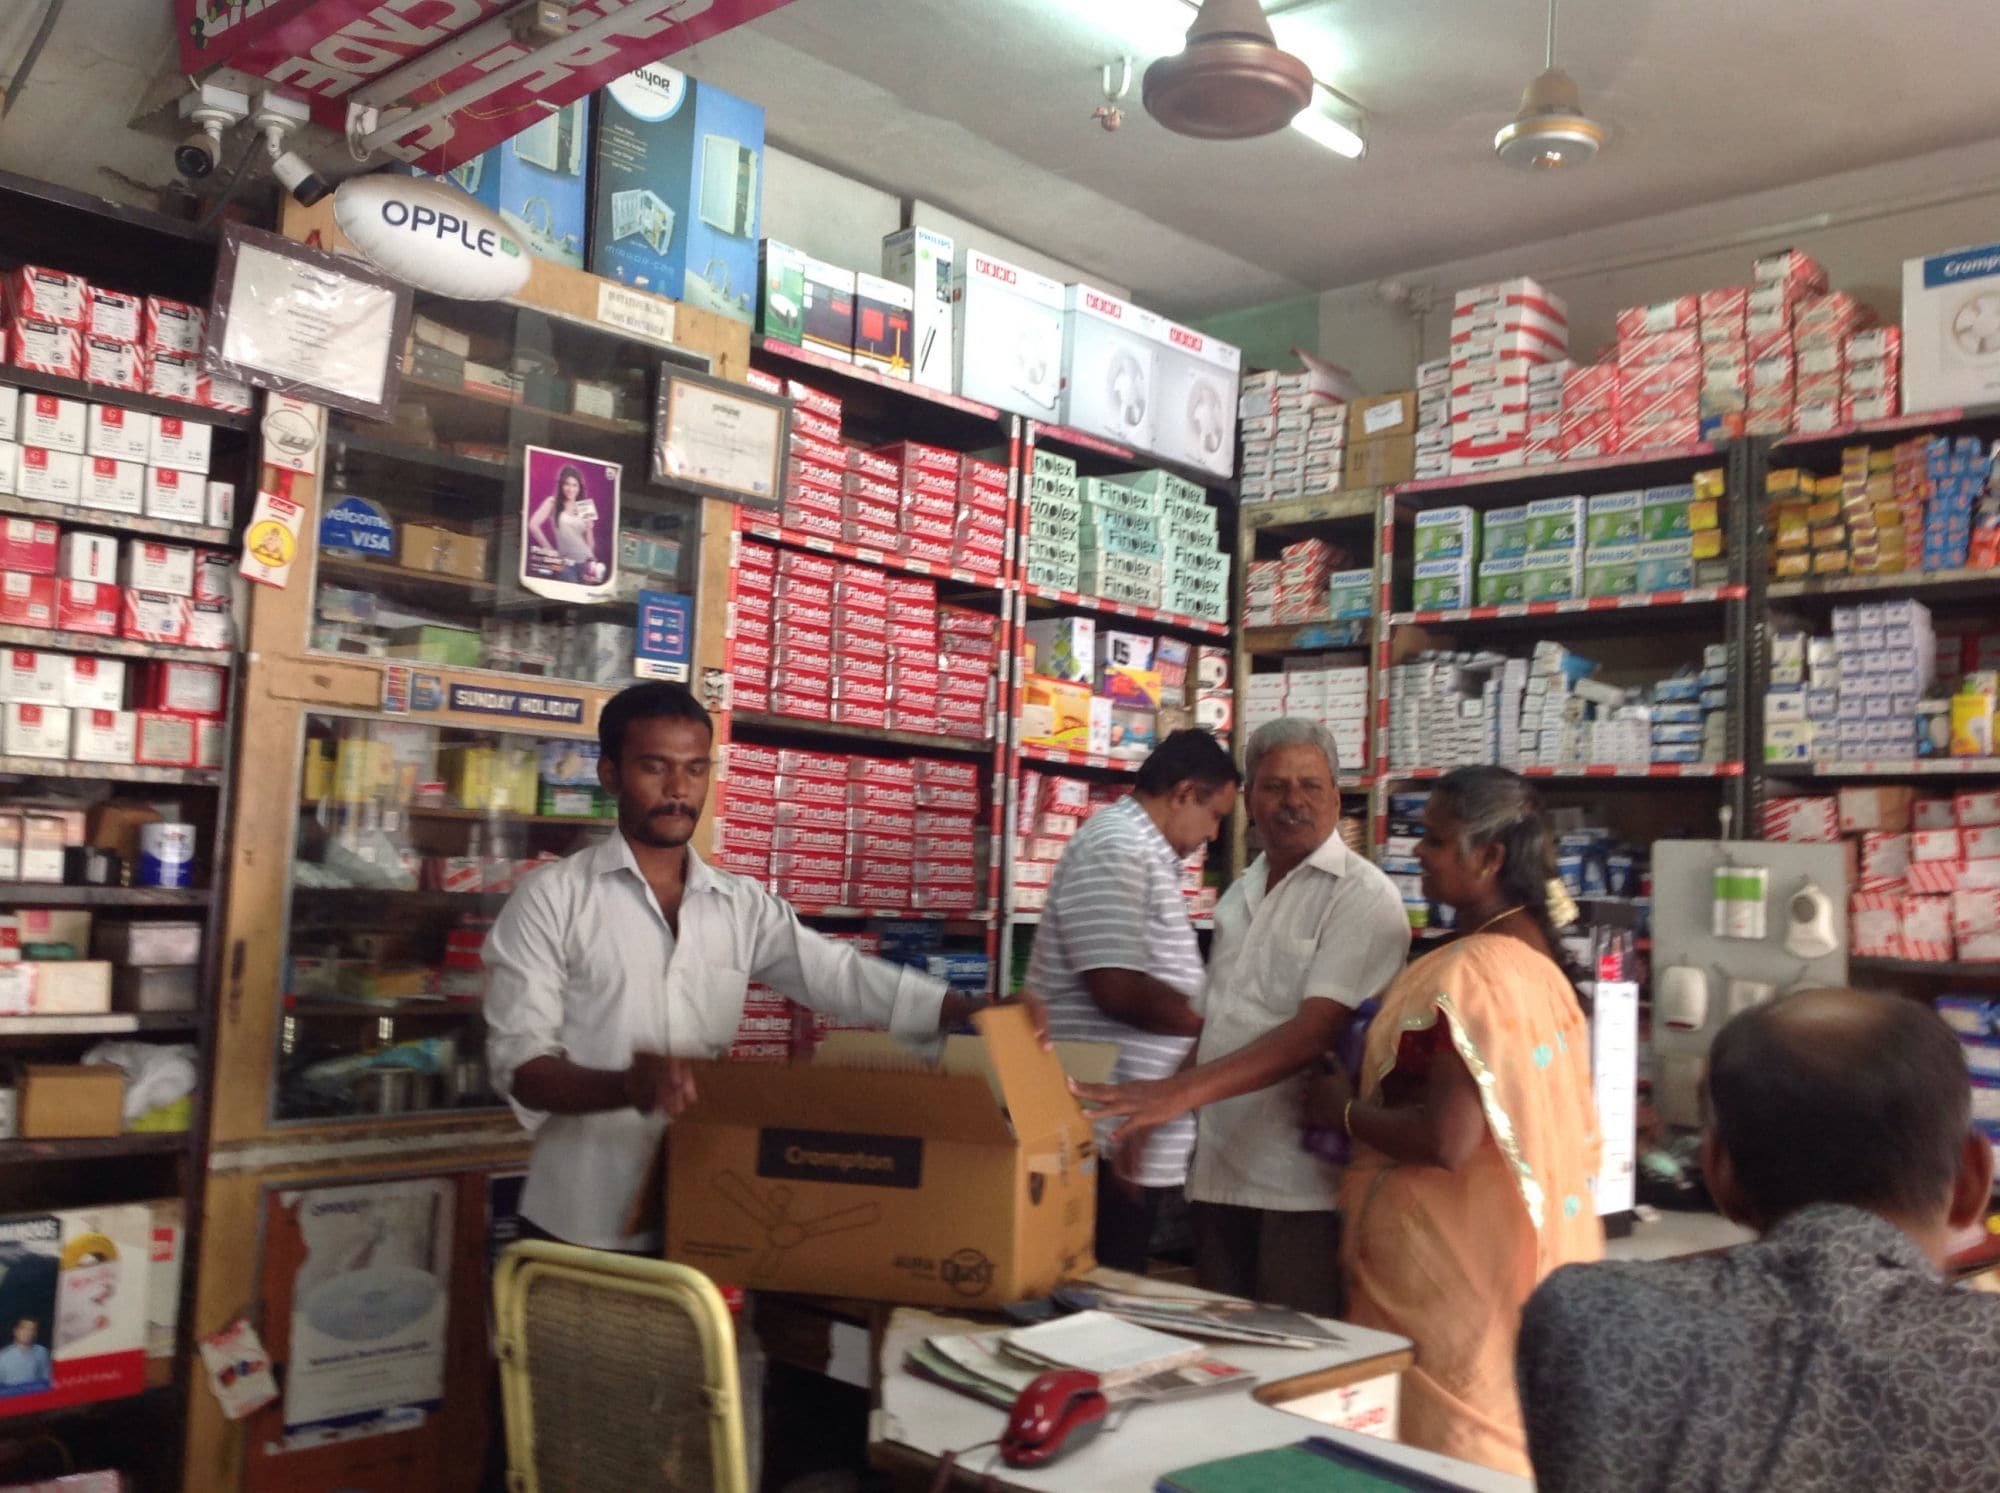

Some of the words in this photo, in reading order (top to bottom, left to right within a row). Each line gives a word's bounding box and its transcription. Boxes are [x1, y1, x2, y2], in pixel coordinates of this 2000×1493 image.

[381, 199, 496, 257] OPPLE
[918, 231, 951, 249] PHILIPS
[747, 373, 780, 394] nolex
[802, 417, 840, 437] Finolex
[805, 438, 847, 460] Finolex
[920, 448, 958, 464] Finolex
[801, 461, 842, 483] Finolex
[860, 453, 898, 474] Finolex
[974, 462, 1008, 479] Finolex
[1035, 456, 1072, 476] nolex
[860, 478, 899, 499] Finolex
[920, 472, 956, 488] Finolex
[1032, 476, 1075, 497] inolex
[1166, 476, 1201, 501] Finolex
[801, 485, 841, 506] Finolex
[917, 494, 955, 510] Finolex
[974, 486, 1007, 504] Finolex
[1100, 483, 1147, 509] Finolex
[1592, 496, 1636, 509] PHILIPS
[858, 502, 896, 522] Finolex
[1164, 498, 1210, 523] Finolex
[1531, 500, 1574, 513] PHILIPS
[801, 510, 842, 531] Finolex
[914, 515, 952, 531] Finolex
[972, 509, 1005, 526] Finolex
[1105, 510, 1149, 531] Finolex
[1418, 512, 1461, 523] PHILIPS
[351, 529, 391, 551] VISA
[858, 525, 897, 545] Finolex
[968, 529, 1005, 546] Finolex
[1110, 530, 1156, 552] Finolex
[1171, 522, 1213, 547] Finolex
[741, 546, 773, 560] nolex
[911, 538, 952, 555] Finolex
[1642, 543, 1687, 554] PHILIPS
[792, 556, 833, 574] Finolex
[962, 550, 1000, 567] Finolex
[1106, 552, 1150, 576] Finolex
[1175, 546, 1222, 571] Finolex
[1527, 554, 1570, 565] PHILIPS
[1588, 551, 1633, 562] PHILIPS
[740, 569, 771, 584] nolex
[1417, 562, 1458, 574] PHILIPS
[1174, 569, 1219, 593] Finolex
[1334, 572, 1370, 583] PHILIPS
[788, 579, 829, 596] Finolex
[1105, 577, 1150, 600] Finolex
[738, 594, 769, 608] nolex
[1175, 592, 1220, 615] Finolex
[788, 603, 832, 620] Finolex
[738, 618, 768, 632] nolex
[789, 627, 830, 644] Finolex
[736, 642, 769, 655] nolex
[789, 650, 830, 667] Finolex
[734, 665, 766, 678] nolex
[785, 671, 828, 689] Finolex
[455, 689, 515, 711] SUNDAY
[518, 696, 580, 717] HOLIDAY
[734, 689, 766, 702] nolex
[784, 695, 828, 711] Finolex
[800, 755, 848, 770] Finolex
[865, 759, 913, 776] Finolex
[928, 762, 973, 779] Finolex
[797, 779, 846, 795] Finolex
[865, 785, 913, 800] Finolex
[934, 787, 977, 801] Finolex
[798, 805, 846, 820] Finolex
[865, 811, 913, 826] Finolex
[929, 814, 973, 827] Finolex
[797, 829, 844, 844] Finolex
[865, 835, 913, 850] Finolex
[929, 837, 974, 850] Finolex
[796, 855, 843, 870] Finolex
[863, 860, 911, 875] Finolex
[930, 863, 974, 875] Finolex
[790, 881, 840, 895] Finolex
[861, 884, 908, 898] Finolex
[930, 887, 975, 900] Finolex
[785, 1146, 895, 1171] Crompton
